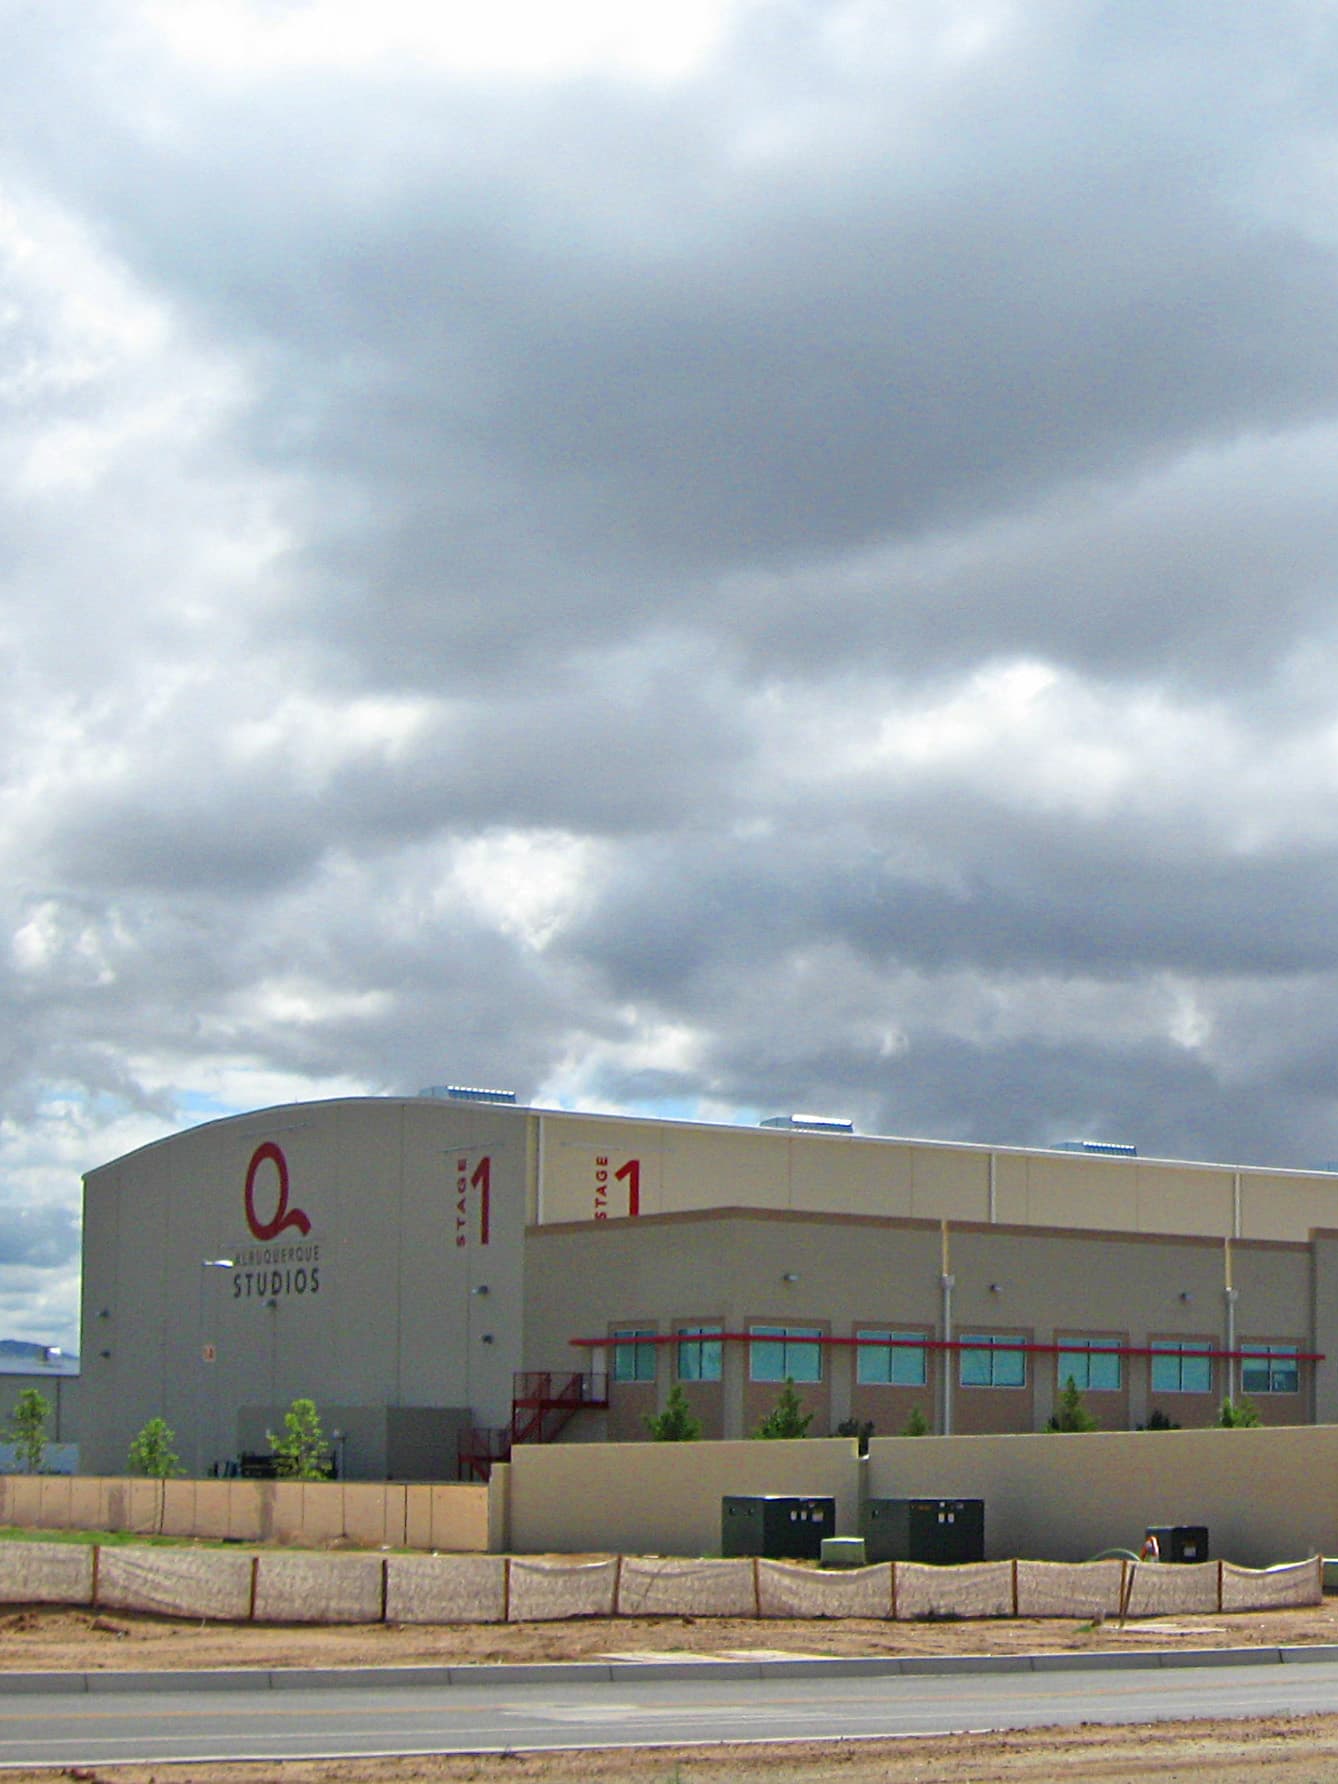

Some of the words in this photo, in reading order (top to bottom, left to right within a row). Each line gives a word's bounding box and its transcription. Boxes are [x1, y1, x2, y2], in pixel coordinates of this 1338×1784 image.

[245, 1142, 311, 1241] Q
[456, 1158, 468, 1248] STAGE
[471, 1155, 491, 1245] 1
[595, 1156, 608, 1220] STAGE
[615, 1160, 640, 1216] 1
[233, 1268, 320, 1299] STUDIOS
[235, 1245, 320, 1267] ALBUQUERQUE
